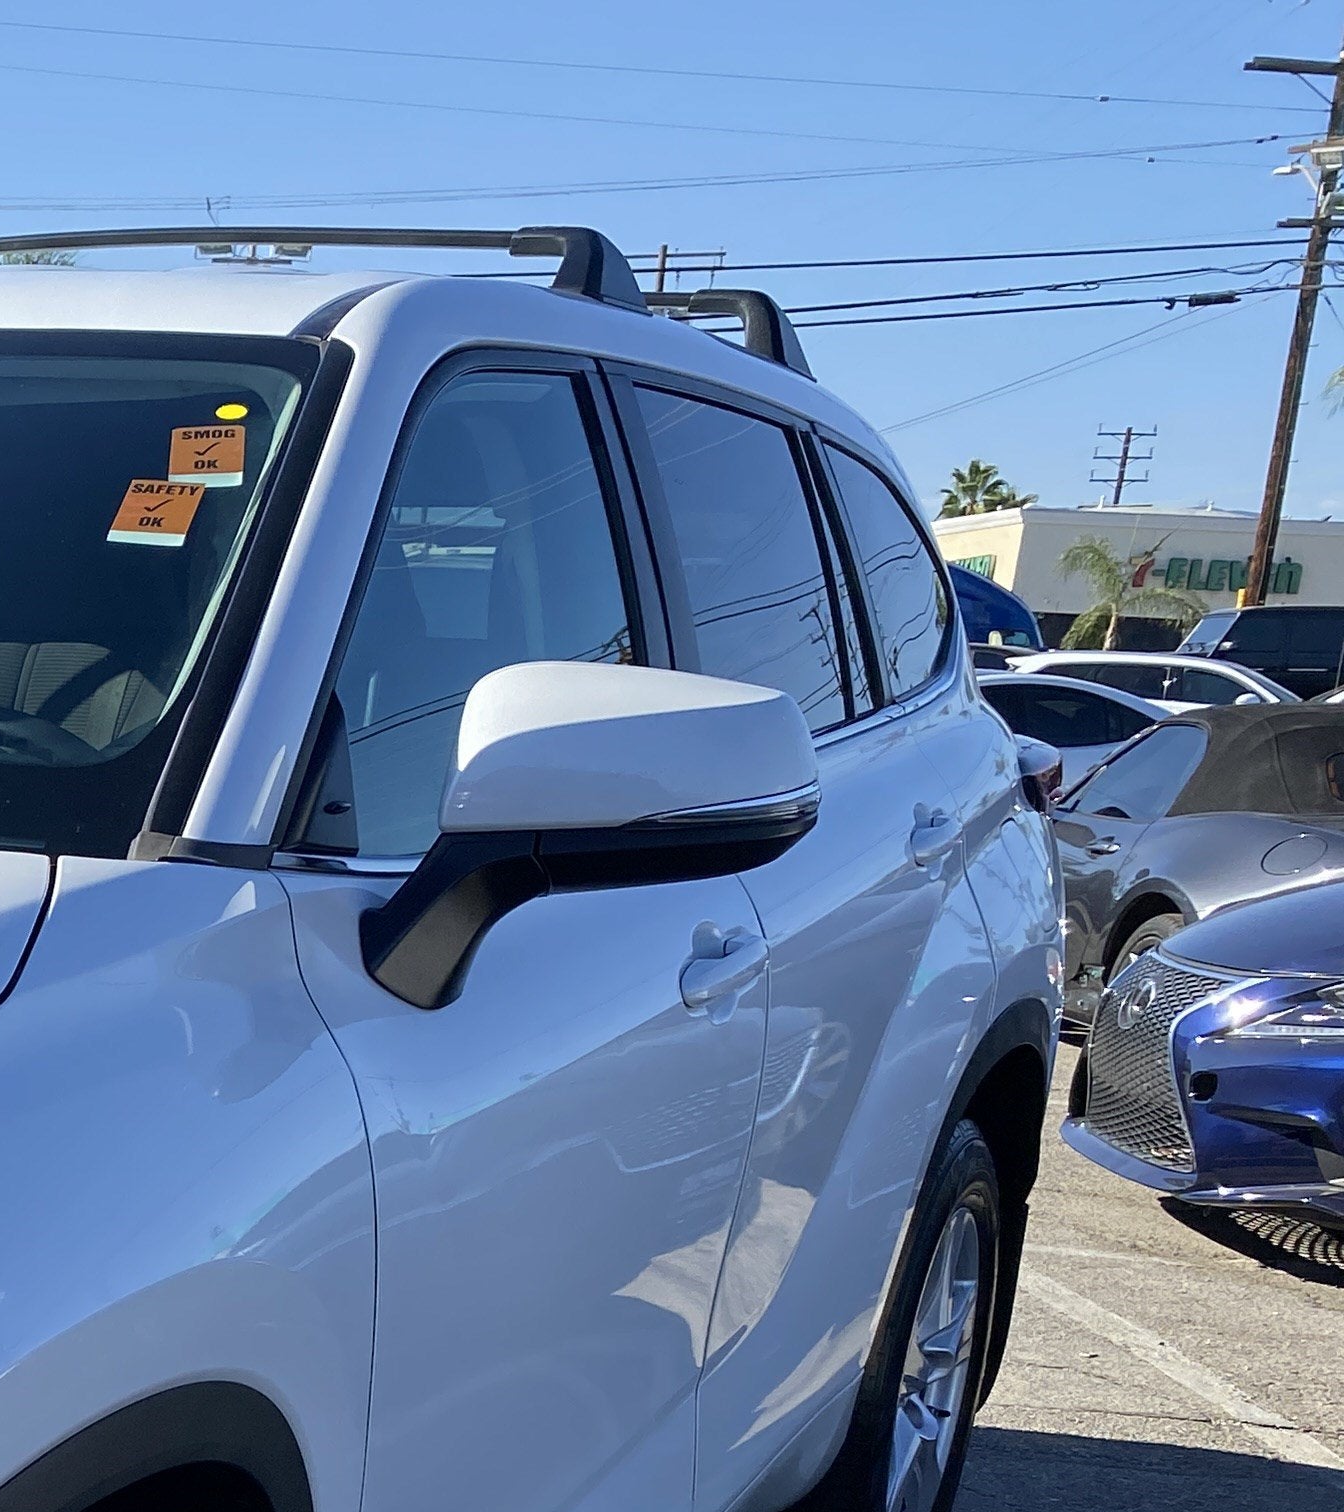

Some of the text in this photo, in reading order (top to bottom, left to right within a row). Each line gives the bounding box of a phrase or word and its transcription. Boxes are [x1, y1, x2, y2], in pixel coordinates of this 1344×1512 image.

[181, 428, 236, 440] SMOG
[193, 459, 219, 470] OK
[131, 483, 201, 496] SAFETY
[138, 516, 165, 528] OK
[1130, 555, 1303, 594] 7-ELEVn
